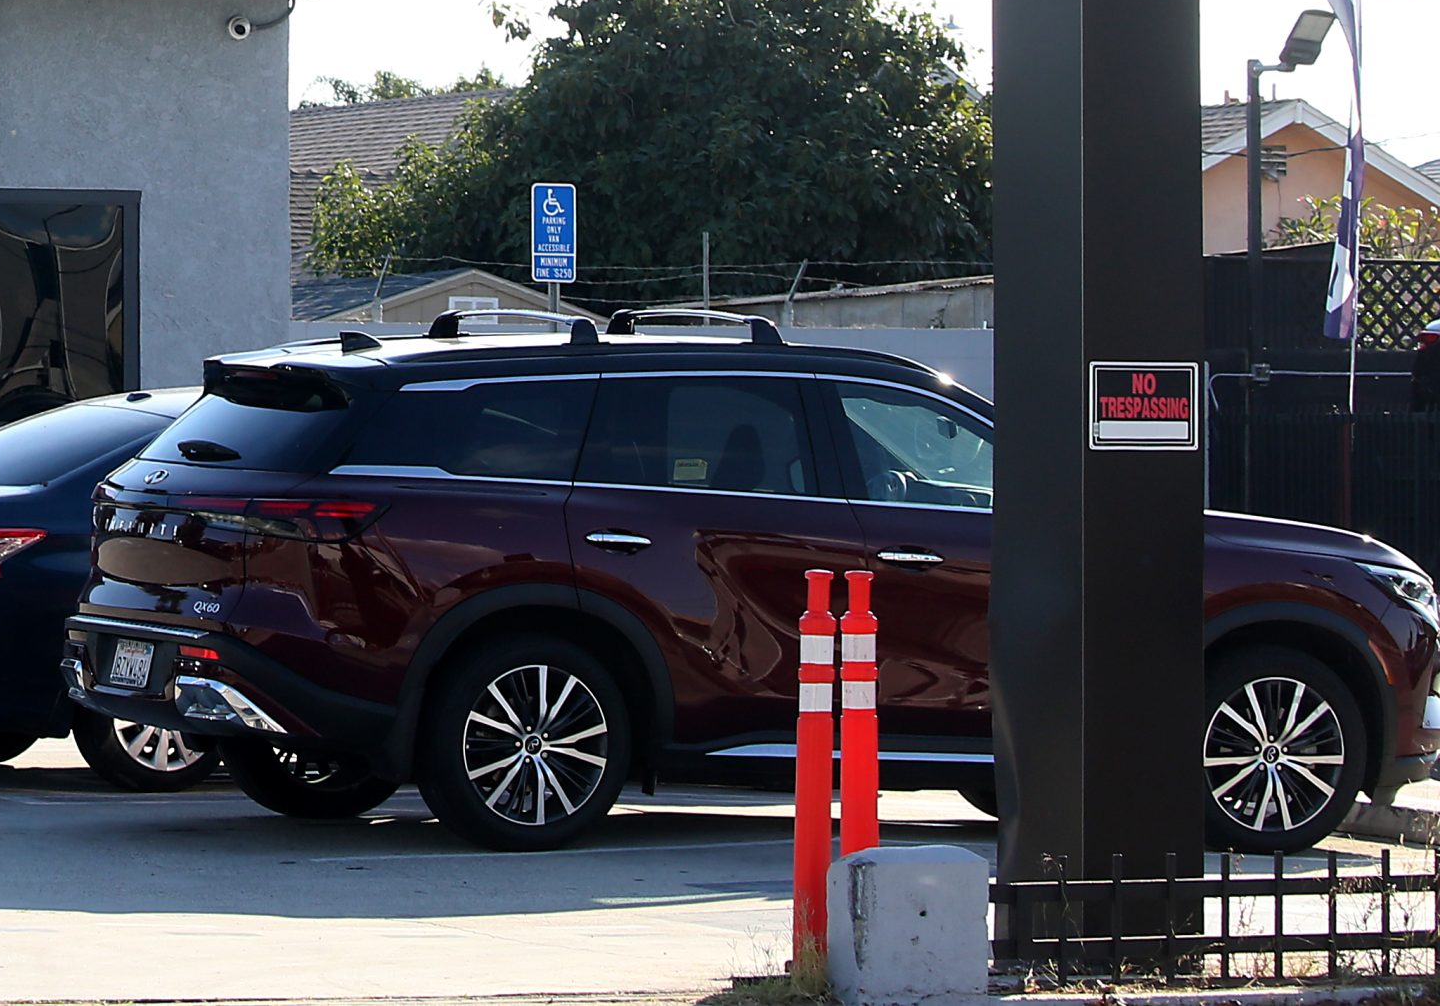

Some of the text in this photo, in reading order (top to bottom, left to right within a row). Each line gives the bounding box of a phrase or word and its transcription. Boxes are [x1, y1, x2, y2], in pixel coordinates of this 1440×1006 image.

[542, 217, 566, 225] PARKING
[546, 226, 562, 234] ONLY
[548, 235, 560, 243] VAN
[538, 244, 570, 252] ACCESSIBLE
[540, 258, 568, 267] MINIMUM
[536, 268, 572, 278] FINE $250
[1131, 373, 1157, 395] NO
[1100, 396, 1189, 419] TRESPASSING
[193, 601, 220, 614] QX60
